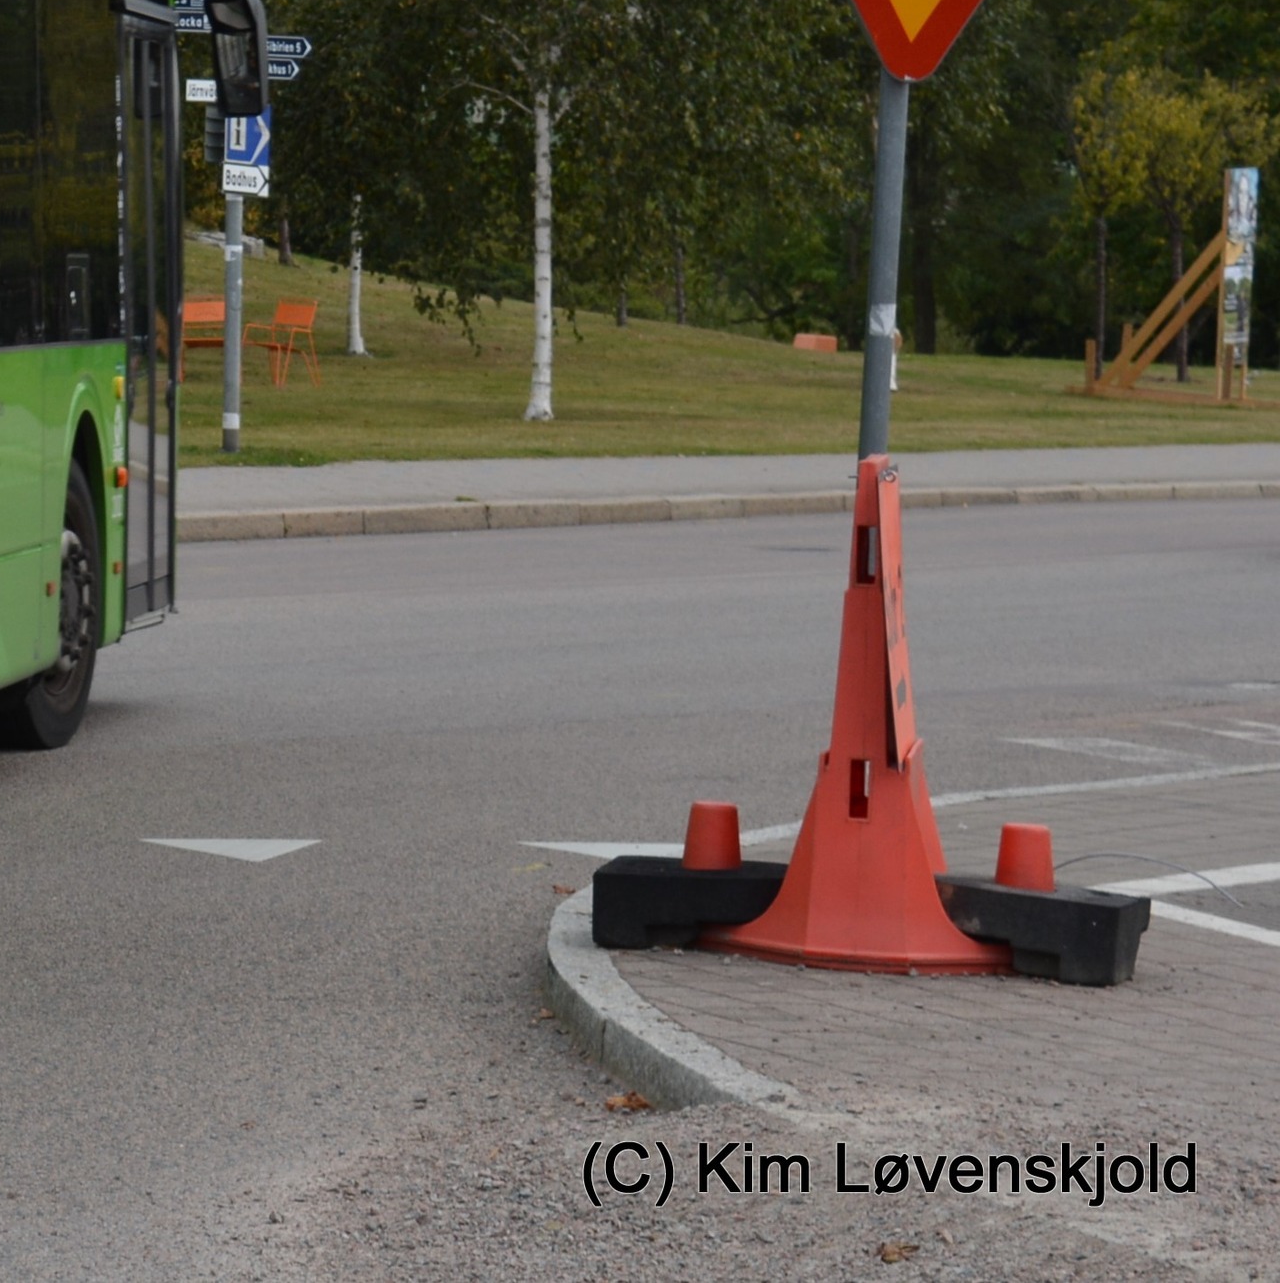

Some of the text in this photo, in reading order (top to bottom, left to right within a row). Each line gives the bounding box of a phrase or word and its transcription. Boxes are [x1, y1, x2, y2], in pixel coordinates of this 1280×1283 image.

[268, 63, 286, 75] khus
[188, 83, 216, 97] Järnvä
[226, 169, 257, 188] Badhus
